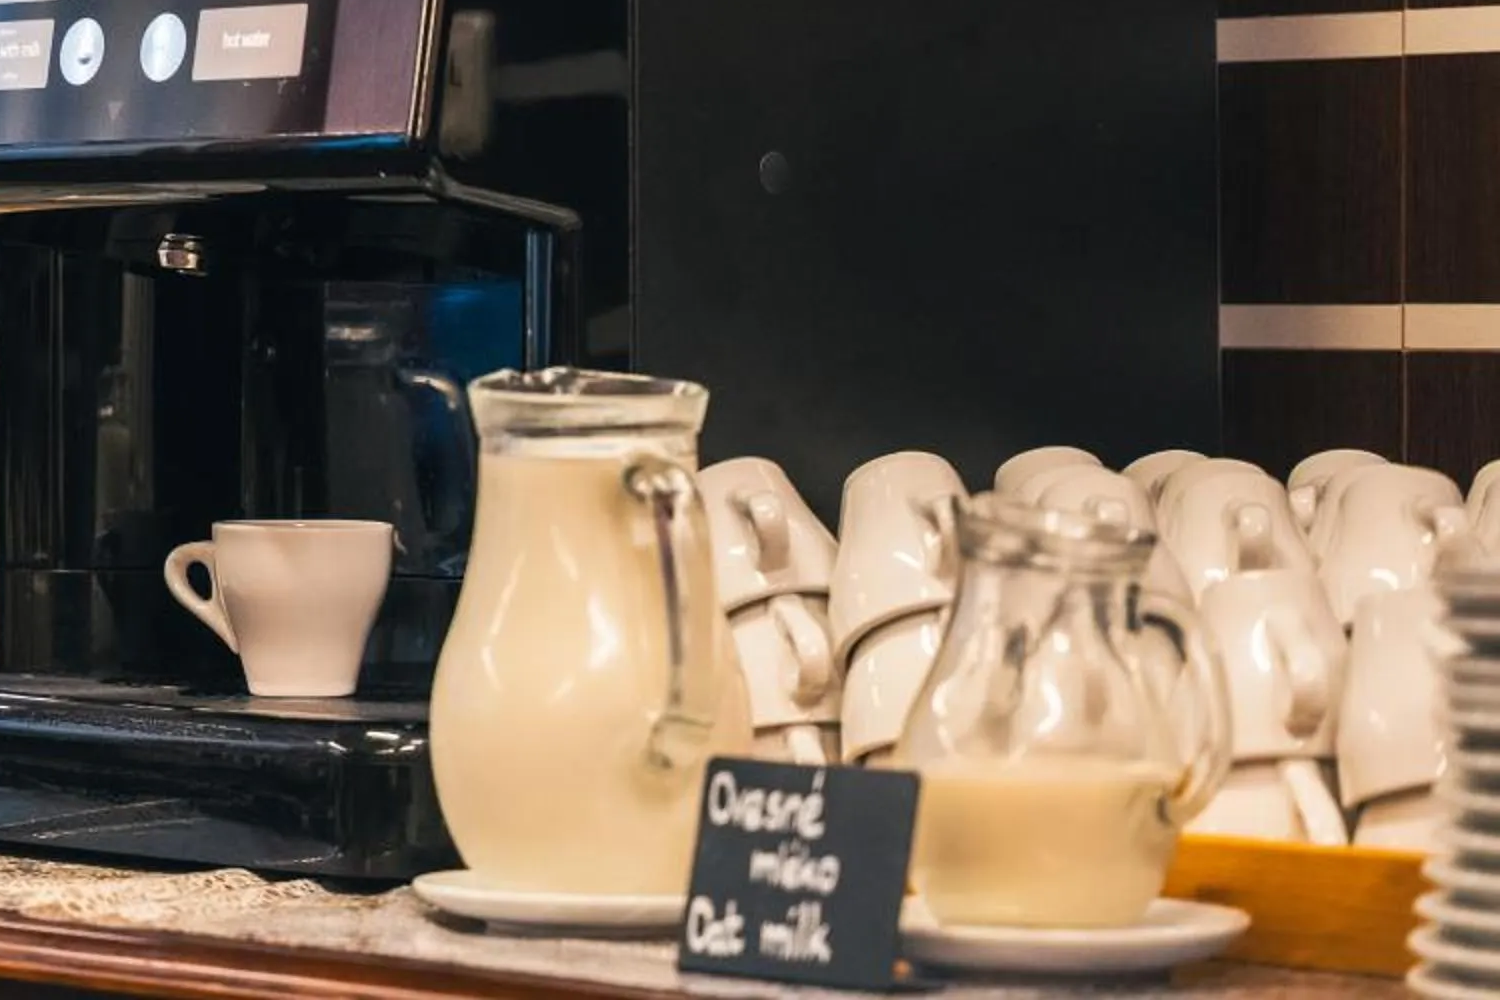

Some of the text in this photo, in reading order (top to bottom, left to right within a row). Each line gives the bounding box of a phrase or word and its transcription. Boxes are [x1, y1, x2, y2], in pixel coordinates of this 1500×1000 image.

[222, 32, 240, 49] hot
[686, 895, 833, 964] Oat milk
